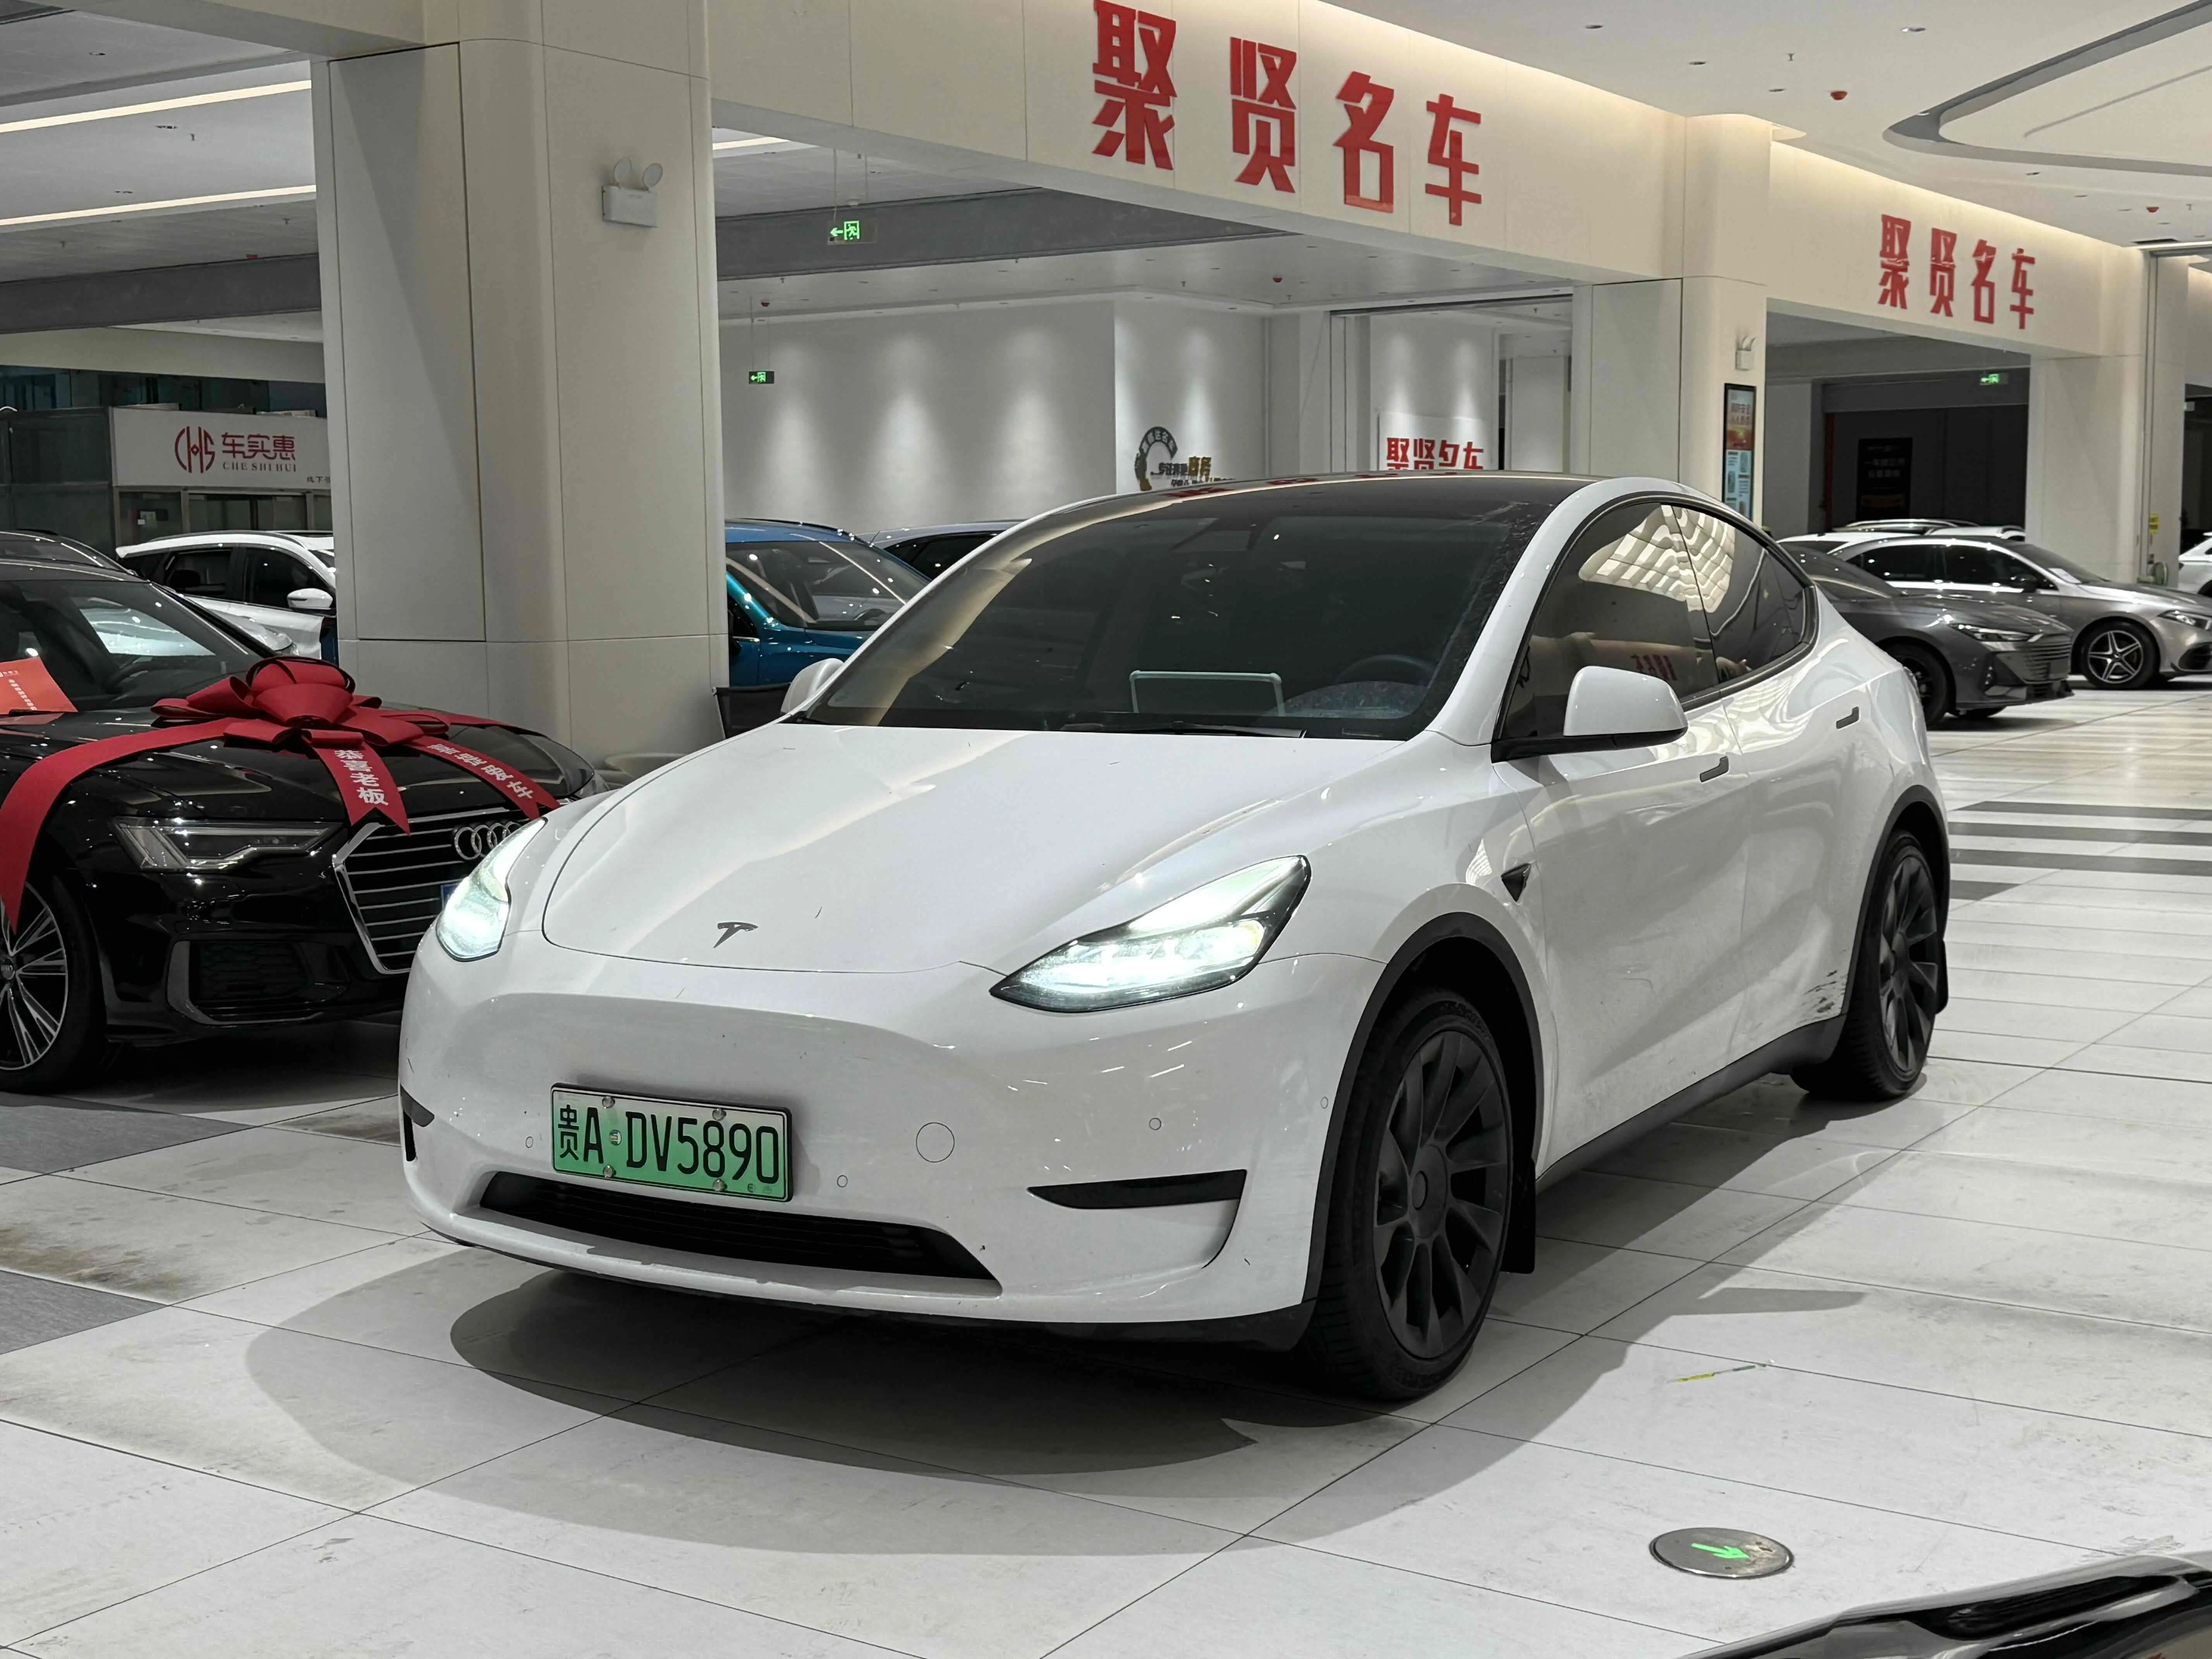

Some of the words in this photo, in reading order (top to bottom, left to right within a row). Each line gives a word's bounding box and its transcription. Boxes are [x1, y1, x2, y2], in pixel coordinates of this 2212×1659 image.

[1092, 0, 1482, 226] 聚贤名车
[1878, 214, 2035, 329] 聚贤名车
[222, 432, 295, 460] 车实惠
[335, 750, 388, 805] 恭喜老板
[427, 744, 533, 799] 喜提爱车
